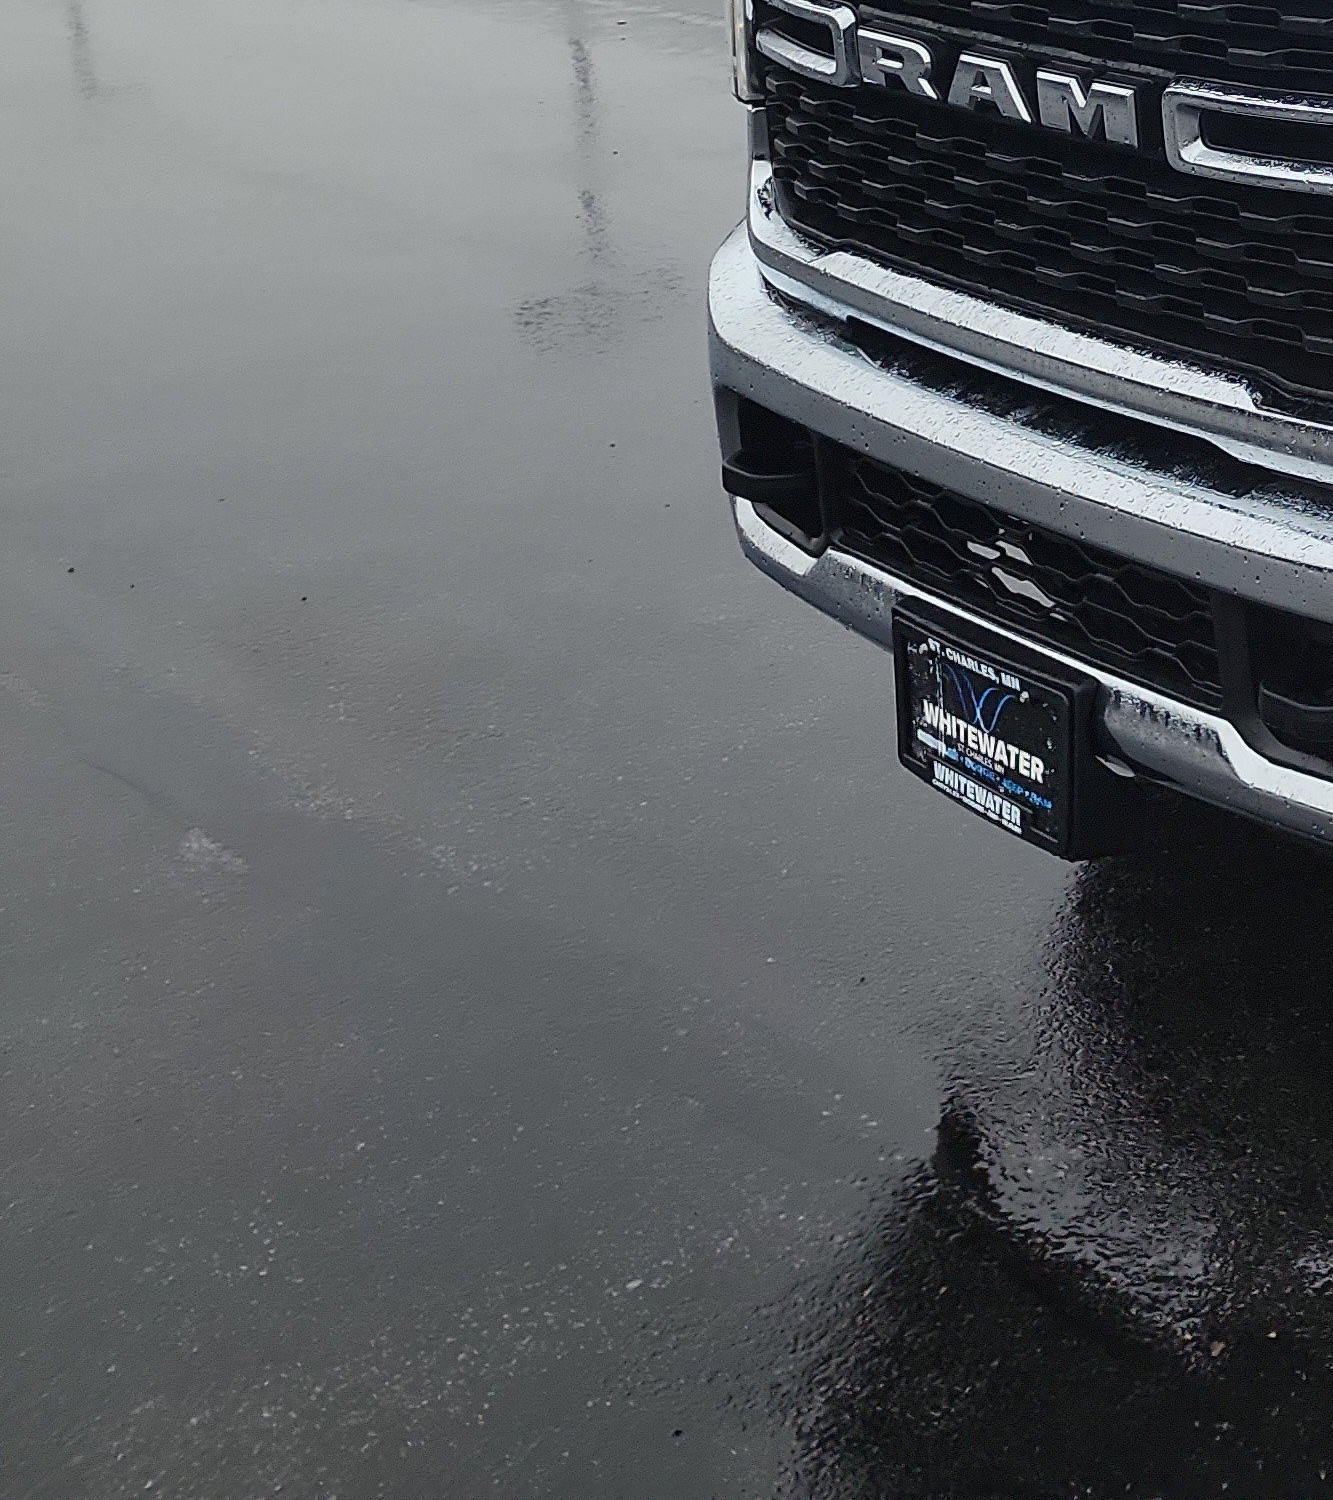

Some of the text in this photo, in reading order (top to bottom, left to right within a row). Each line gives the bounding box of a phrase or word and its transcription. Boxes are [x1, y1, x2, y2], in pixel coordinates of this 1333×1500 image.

[855, 24, 1139, 149] RAM
[923, 699, 1044, 784] WHITEWATER
[933, 760, 1021, 827] WHITEWATER
